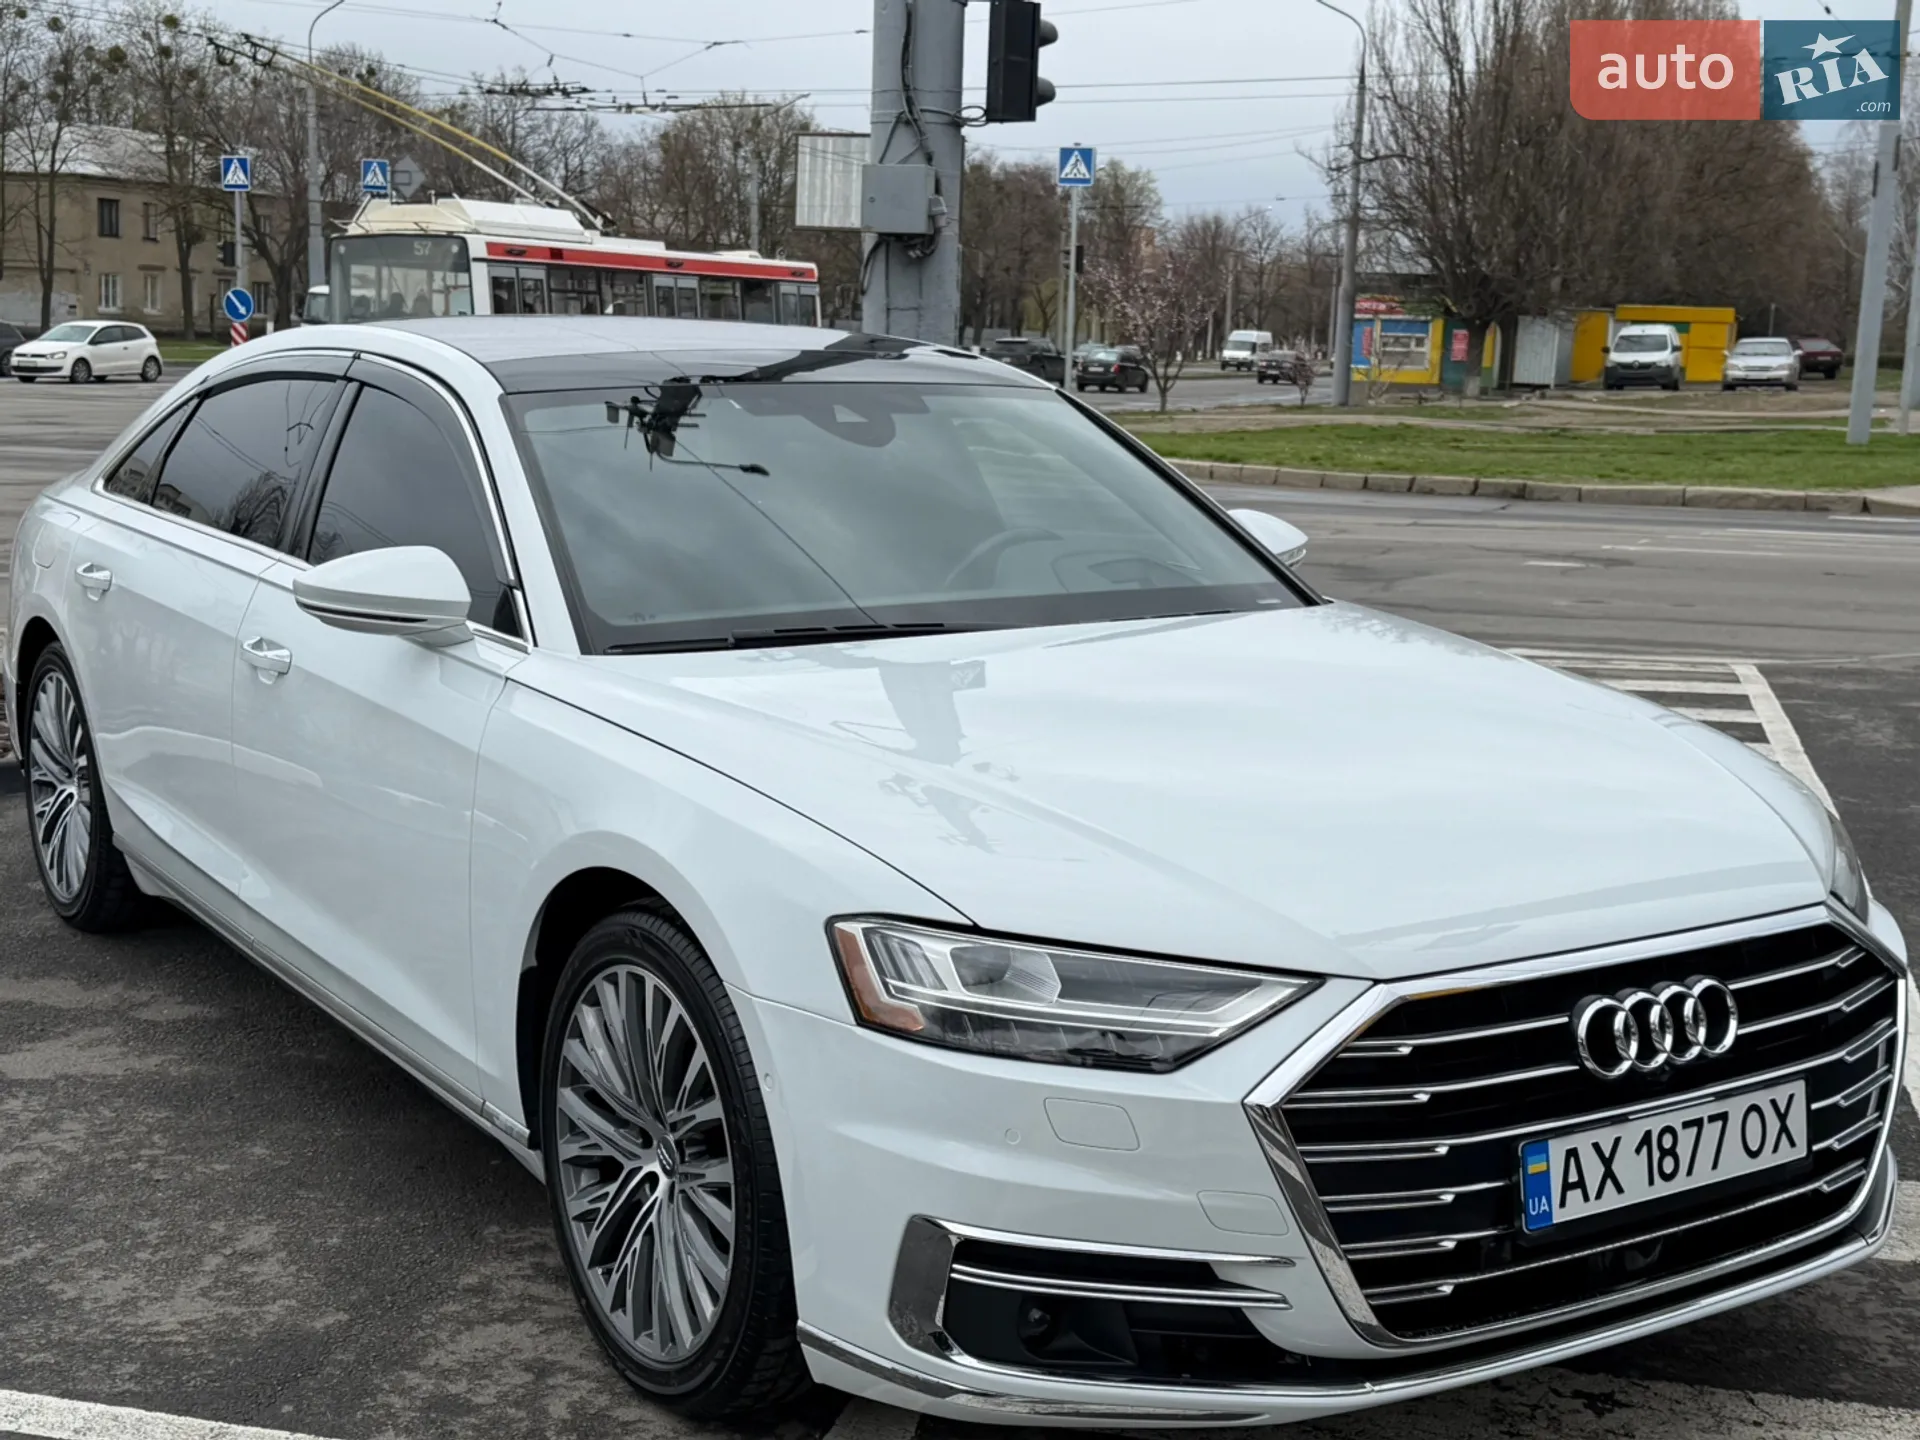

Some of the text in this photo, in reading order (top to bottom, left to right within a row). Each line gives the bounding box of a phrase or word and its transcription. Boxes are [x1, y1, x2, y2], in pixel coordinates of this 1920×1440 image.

[1558, 1092, 1797, 1210] AX 1877 OX
[1528, 1195, 1550, 1216] UA
